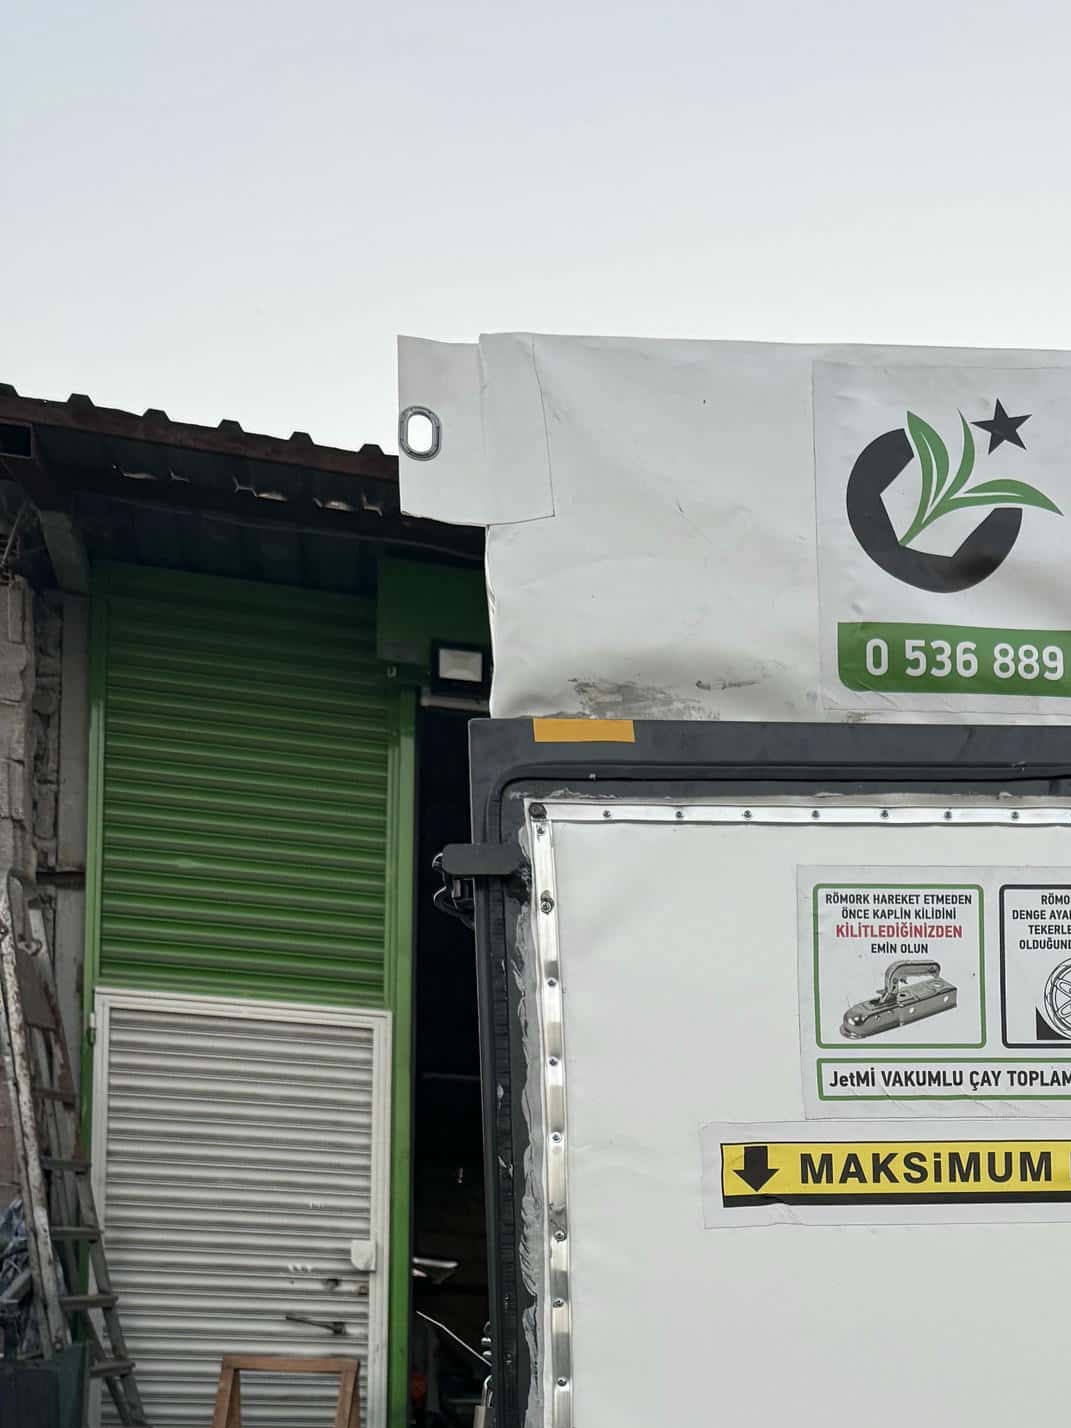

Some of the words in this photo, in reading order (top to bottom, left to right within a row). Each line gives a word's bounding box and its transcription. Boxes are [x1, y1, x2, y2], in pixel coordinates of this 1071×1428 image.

[865, 636, 889, 677] 0
[904, 638, 979, 679] 536
[992, 641, 1065, 681] 889
[825, 892, 869, 904] RÖMORK
[873, 894, 921, 904] HAREKET
[924, 895, 972, 904] ETMEDEN
[842, 907, 869, 919] ÖNCE
[873, 907, 911, 919] KAPLİN
[915, 907, 956, 919] KİLİDİNİ
[1012, 910, 1046, 920] DENGE
[836, 922, 962, 938] KİLİTLEDİĞİNİZDEN
[871, 942, 897, 953] EMİN
[900, 944, 928, 954] OLUN
[881, 1071, 963, 1086] VAKUMLU
[970, 1071, 1001, 1092] ÇAY
